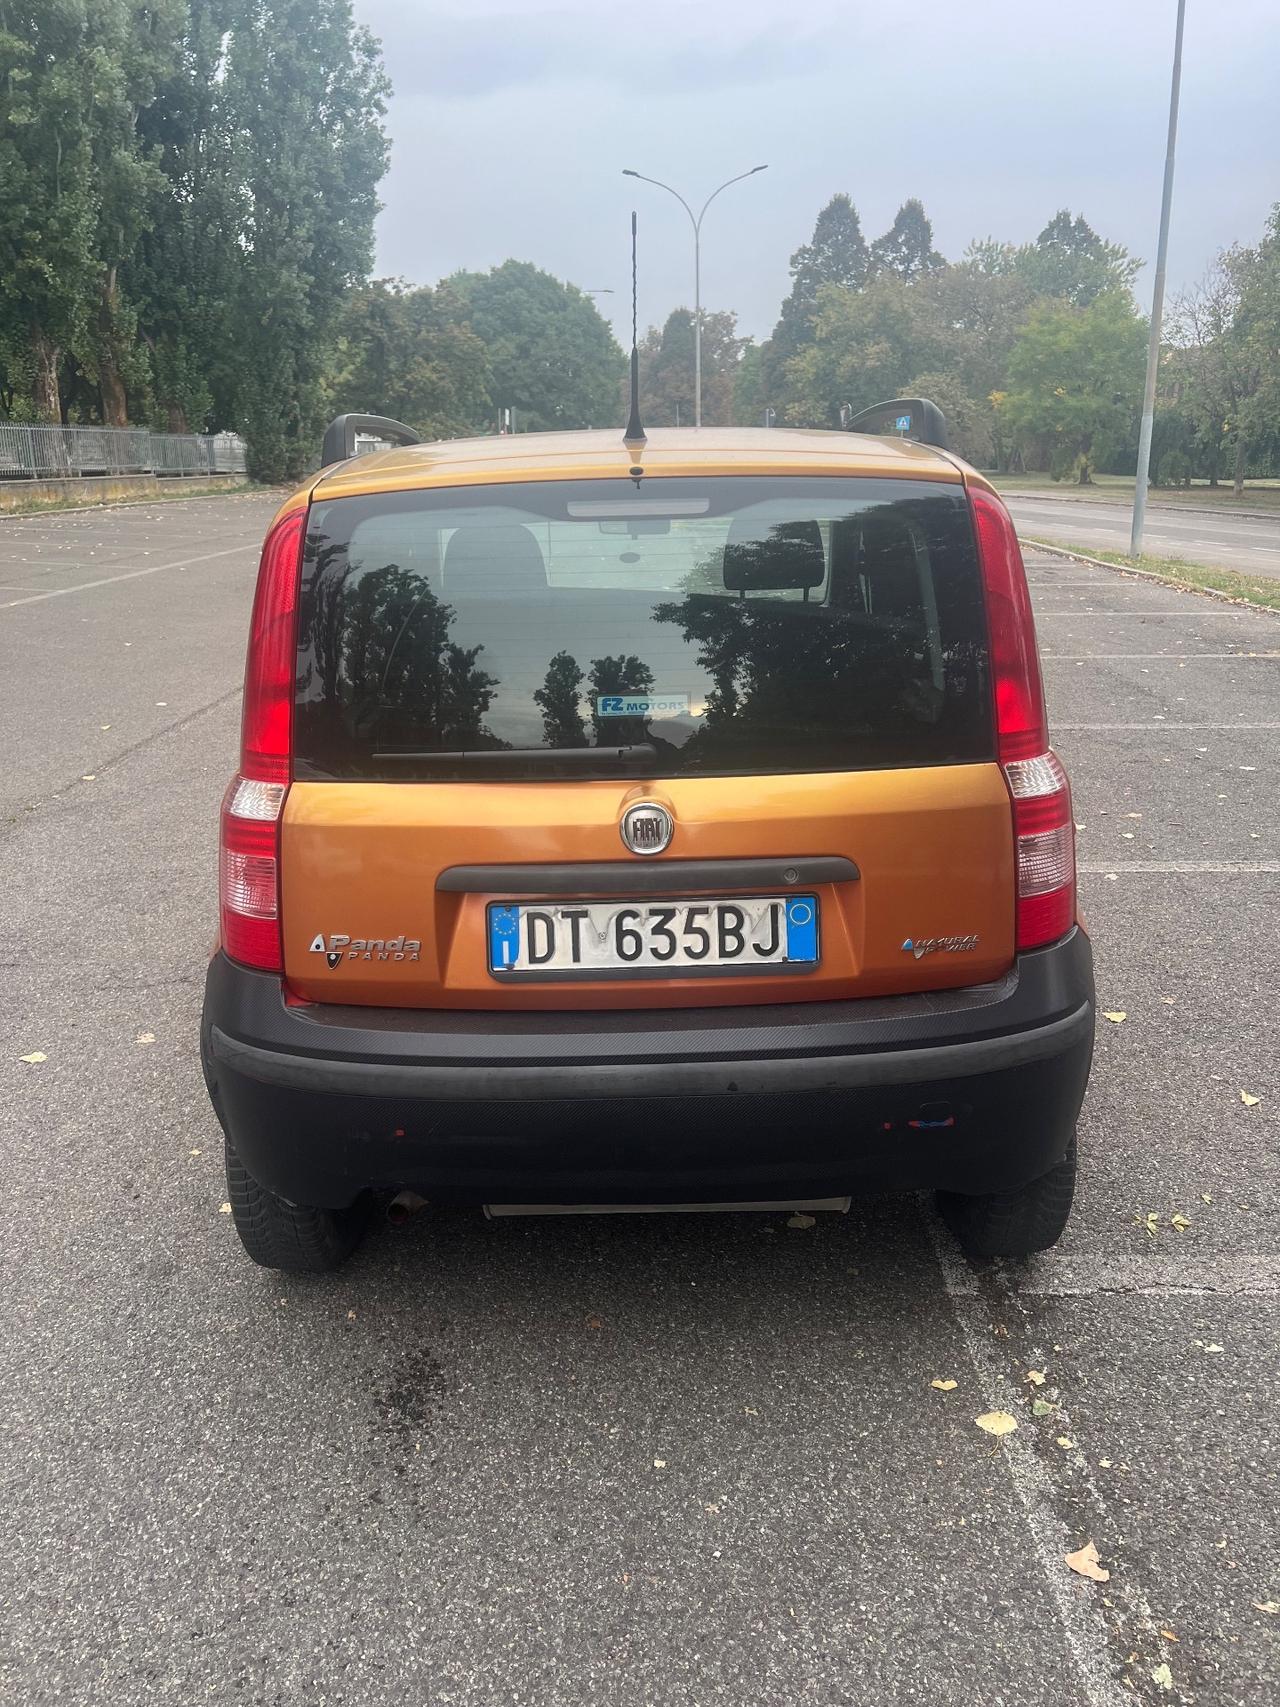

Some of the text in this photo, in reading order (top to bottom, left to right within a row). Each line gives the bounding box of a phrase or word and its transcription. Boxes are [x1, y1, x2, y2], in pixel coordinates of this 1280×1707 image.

[601, 697, 685, 712] FZ MOTORS
[632, 818, 662, 841] FIAT
[526, 904, 780, 964] DT 635BJ
[915, 935, 979, 948] NATURAL
[329, 934, 421, 952] Panda
[348, 952, 420, 961] PANDA
